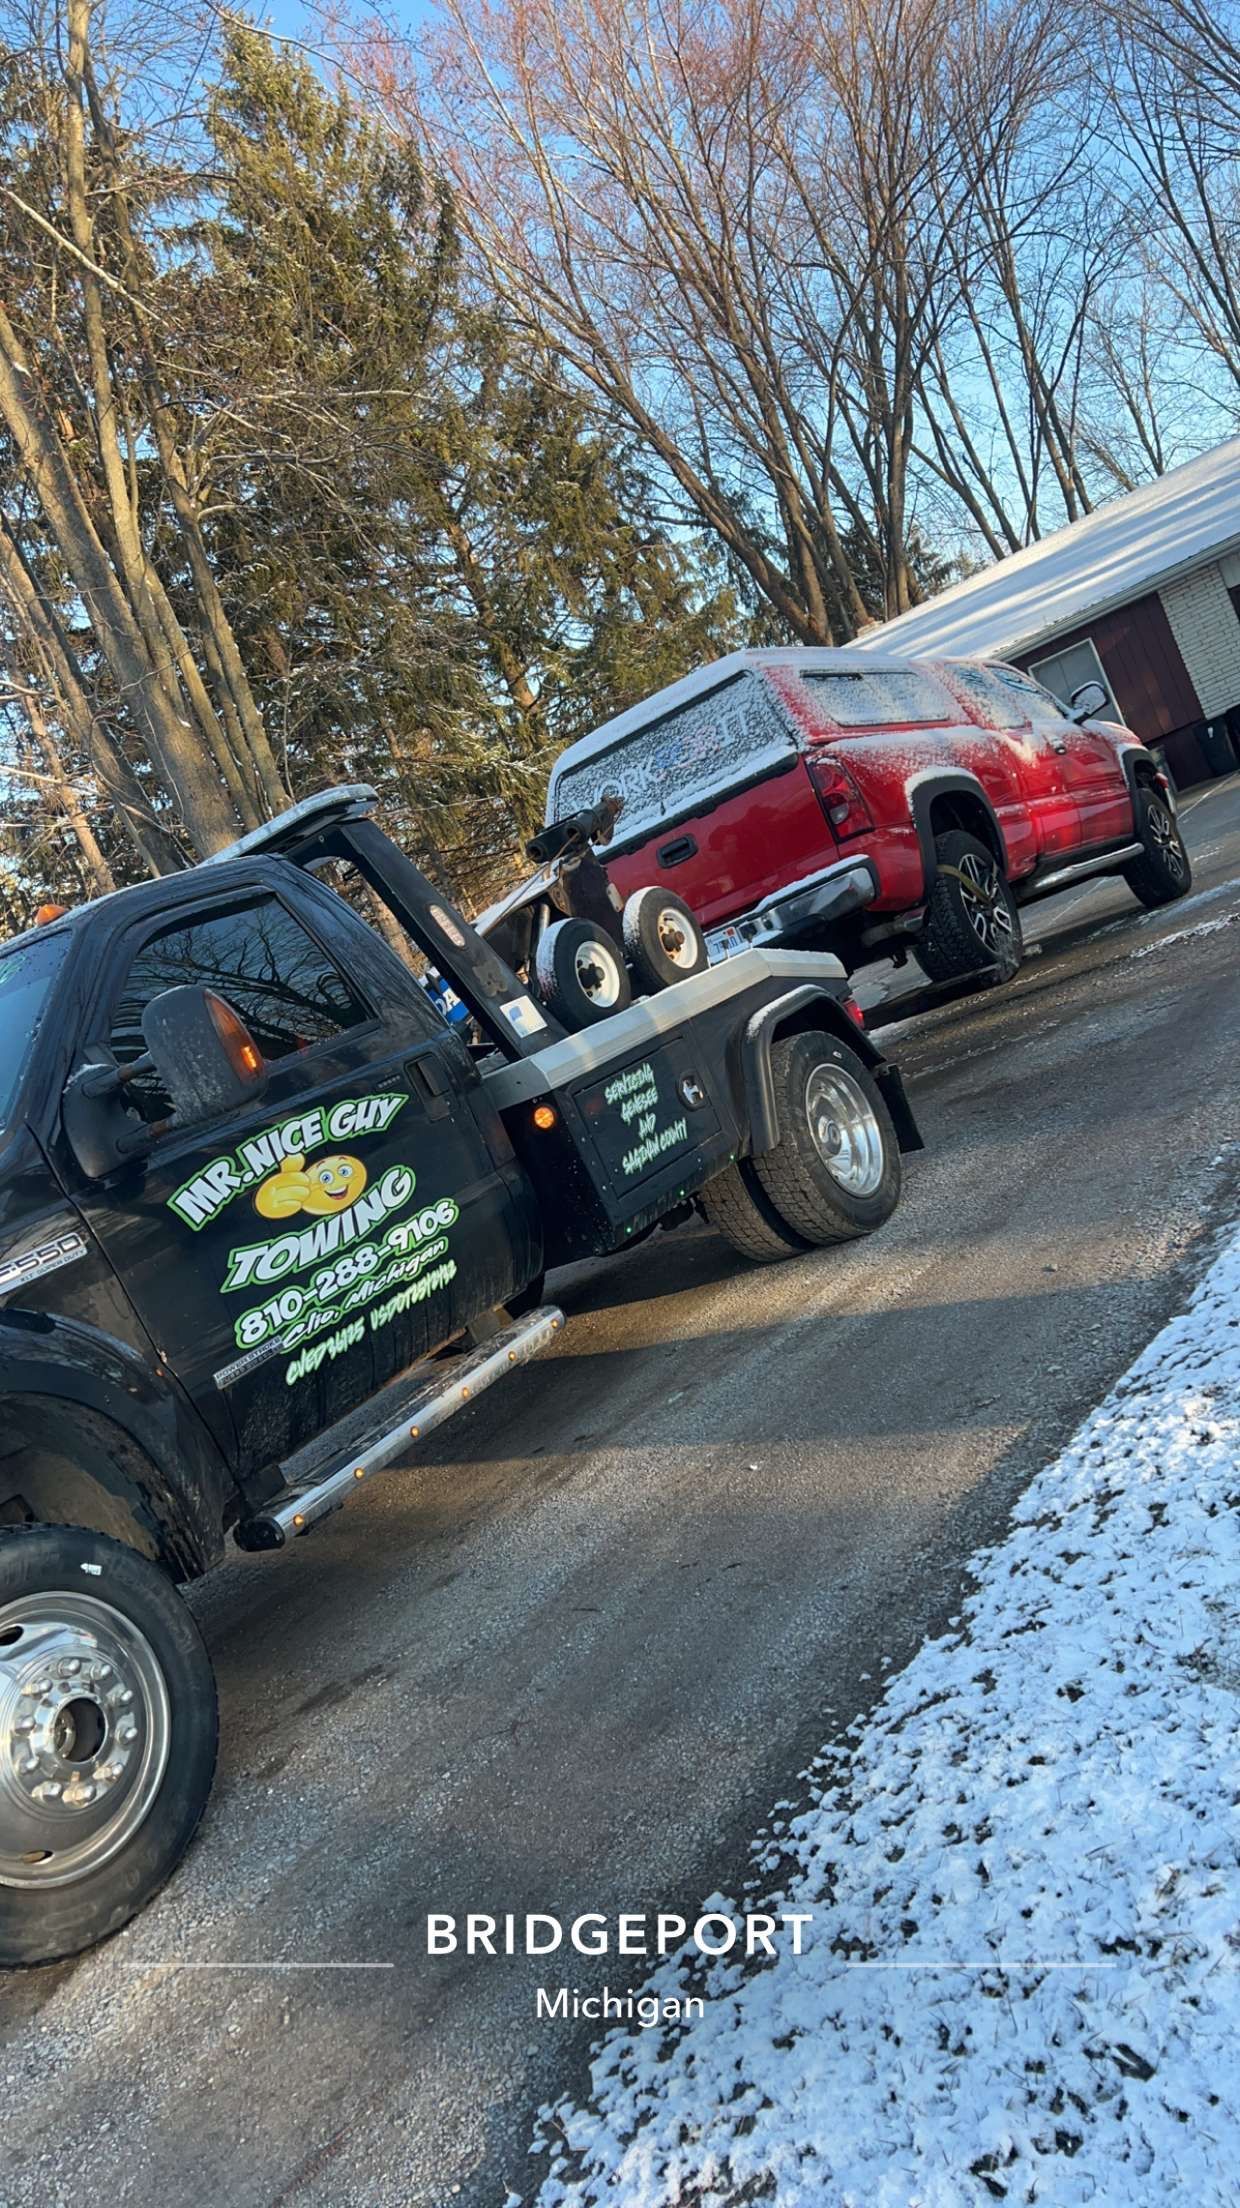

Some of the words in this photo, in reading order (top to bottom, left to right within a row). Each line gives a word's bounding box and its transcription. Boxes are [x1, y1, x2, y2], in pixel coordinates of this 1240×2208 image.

[604, 1062, 656, 1105] SERVICING
[620, 1086, 659, 1126] GENESEE
[239, 1109, 325, 1177] NICE
[329, 1095, 407, 1139] GUY
[621, 1133, 661, 1176] SAGINAW
[659, 1117, 689, 1151] COUNTY
[638, 1112, 657, 1140] AND
[225, 1168, 413, 1289] TOWING
[238, 1200, 457, 1346] 810-288-9106
[281, 1309, 341, 1350] Clio,
[344, 1238, 446, 1310] Michigan
